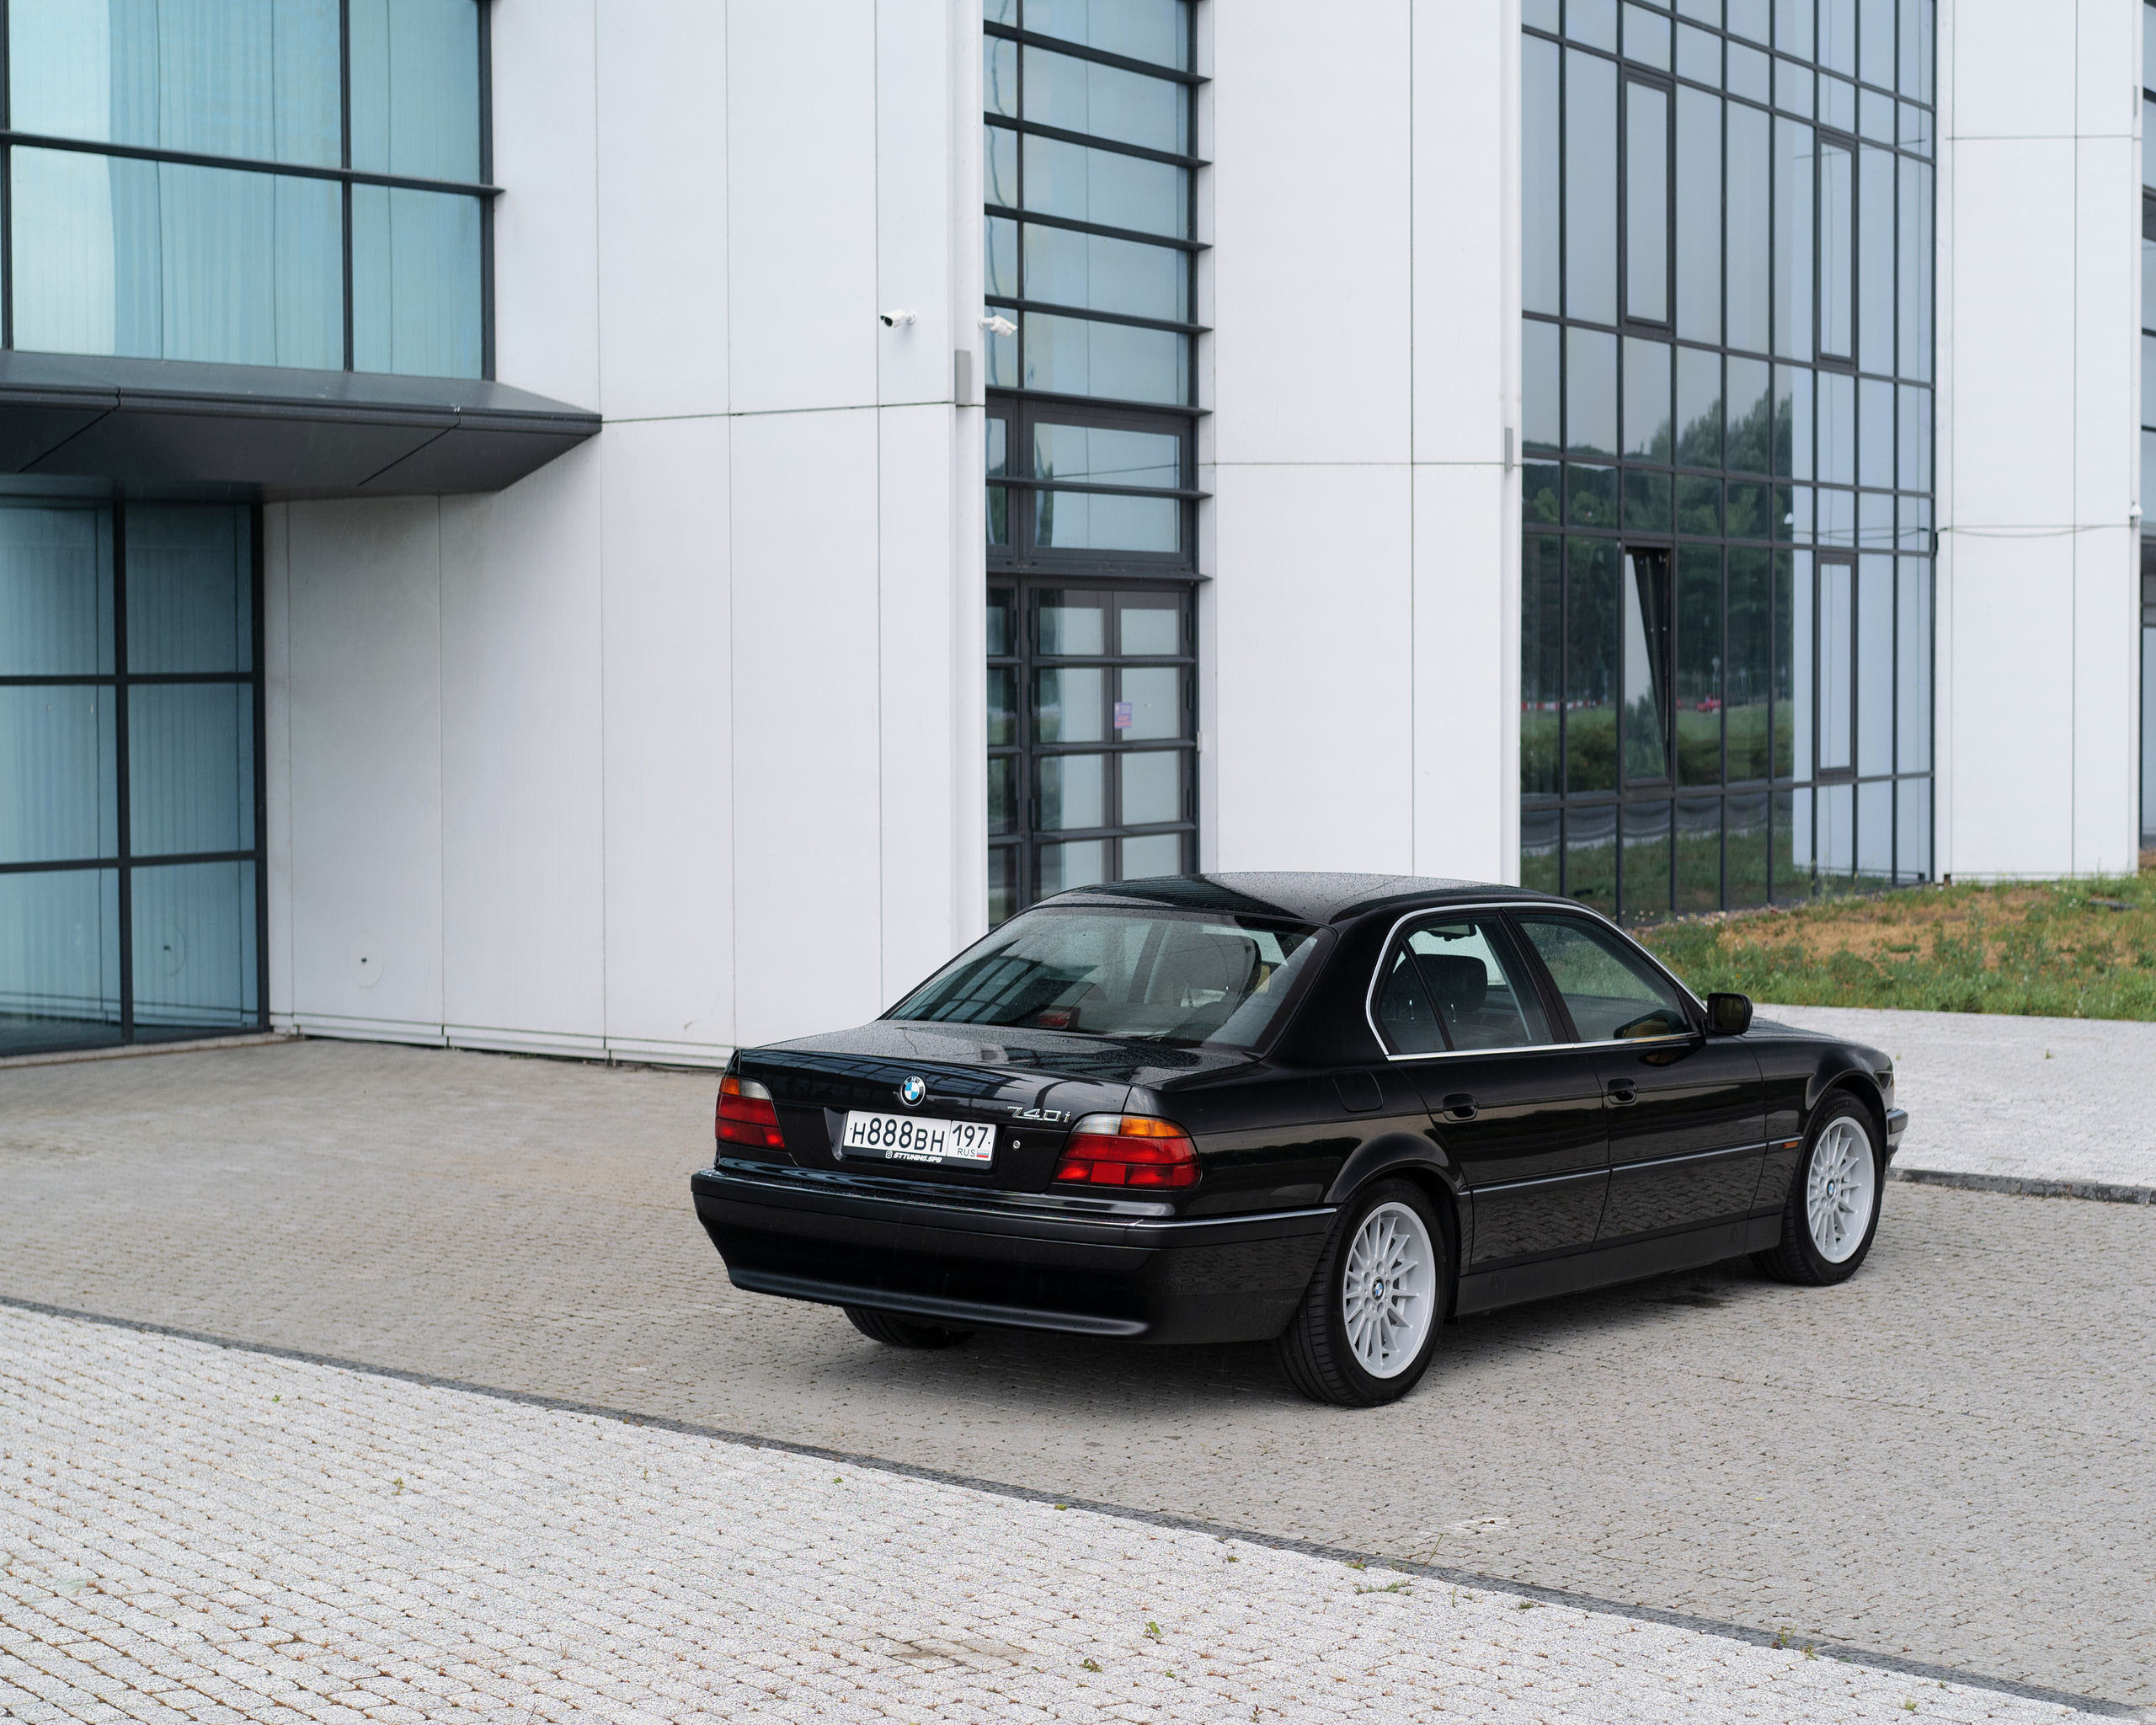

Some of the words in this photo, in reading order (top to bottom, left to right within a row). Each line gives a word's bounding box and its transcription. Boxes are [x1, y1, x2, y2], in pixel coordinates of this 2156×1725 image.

[1006, 1106, 1071, 1123] 740i
[953, 1124, 989, 1149] 197
[957, 1147, 976, 1157] RUS
